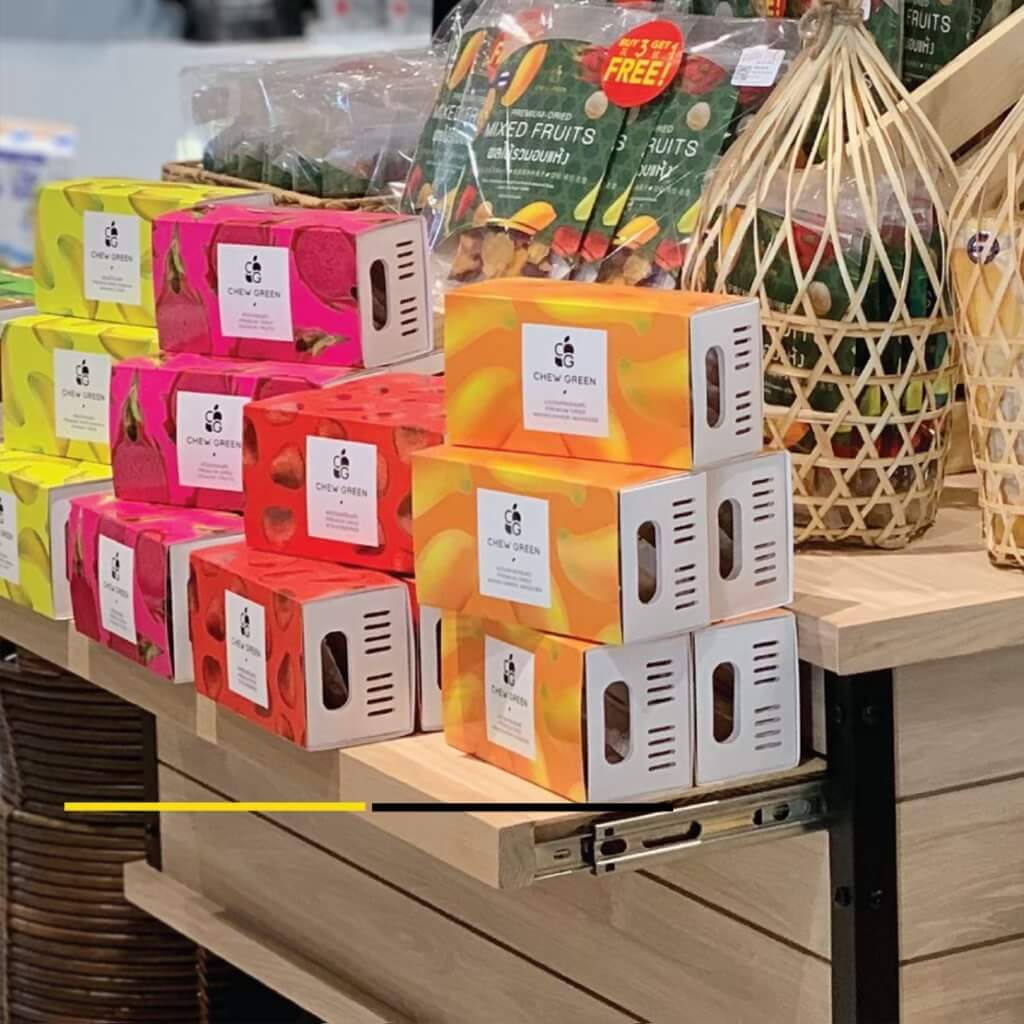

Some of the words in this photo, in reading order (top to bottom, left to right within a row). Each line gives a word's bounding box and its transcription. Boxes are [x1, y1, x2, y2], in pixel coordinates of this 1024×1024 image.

[619, 38, 640, 48] BUY
[635, 39, 651, 58] 3
[650, 40, 673, 50] GET
[603, 56, 672, 87] FREE!
[485, 121, 529, 139] MIXED
[531, 122, 596, 145] FRUITS
[91, 250, 109, 260] CHEW
[112, 252, 133, 263] GREEN
[227, 287, 251, 297] CHEW
[254, 289, 281, 299] GREEN
[533, 371, 561, 383] CHEW
[563, 374, 597, 386] GREEN
[83, 391, 105, 402] GREEN
[186, 436, 210, 446] CHEW
[214, 438, 242, 449] GREEN
[315, 482, 338, 493] CHEW
[341, 485, 368, 497] GREEN
[487, 537, 510, 549] CHEW
[512, 542, 541, 555] GREEN
